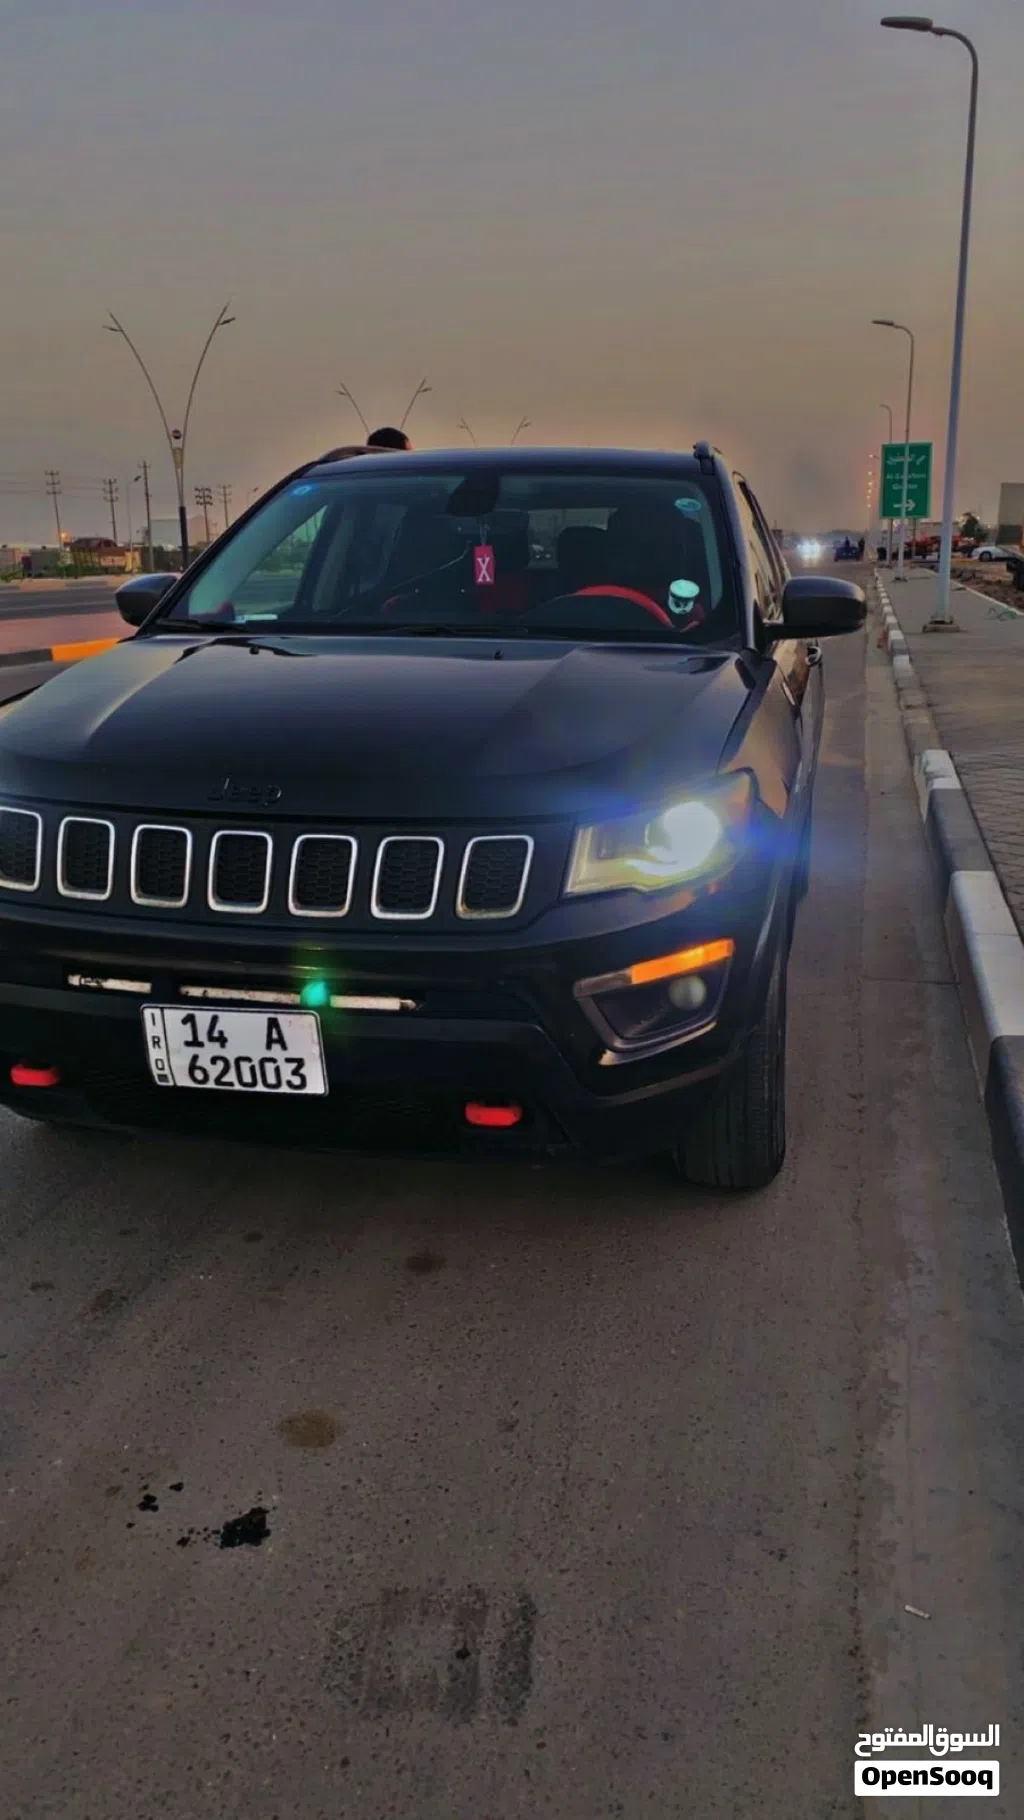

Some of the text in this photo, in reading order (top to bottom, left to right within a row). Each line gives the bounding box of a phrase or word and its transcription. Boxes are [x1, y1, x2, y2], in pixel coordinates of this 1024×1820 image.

[476, 556, 491, 582] X
[206, 776, 282, 807] Jeep
[181, 1013, 288, 1051] 14 A
[188, 1053, 307, 1090] 62003
